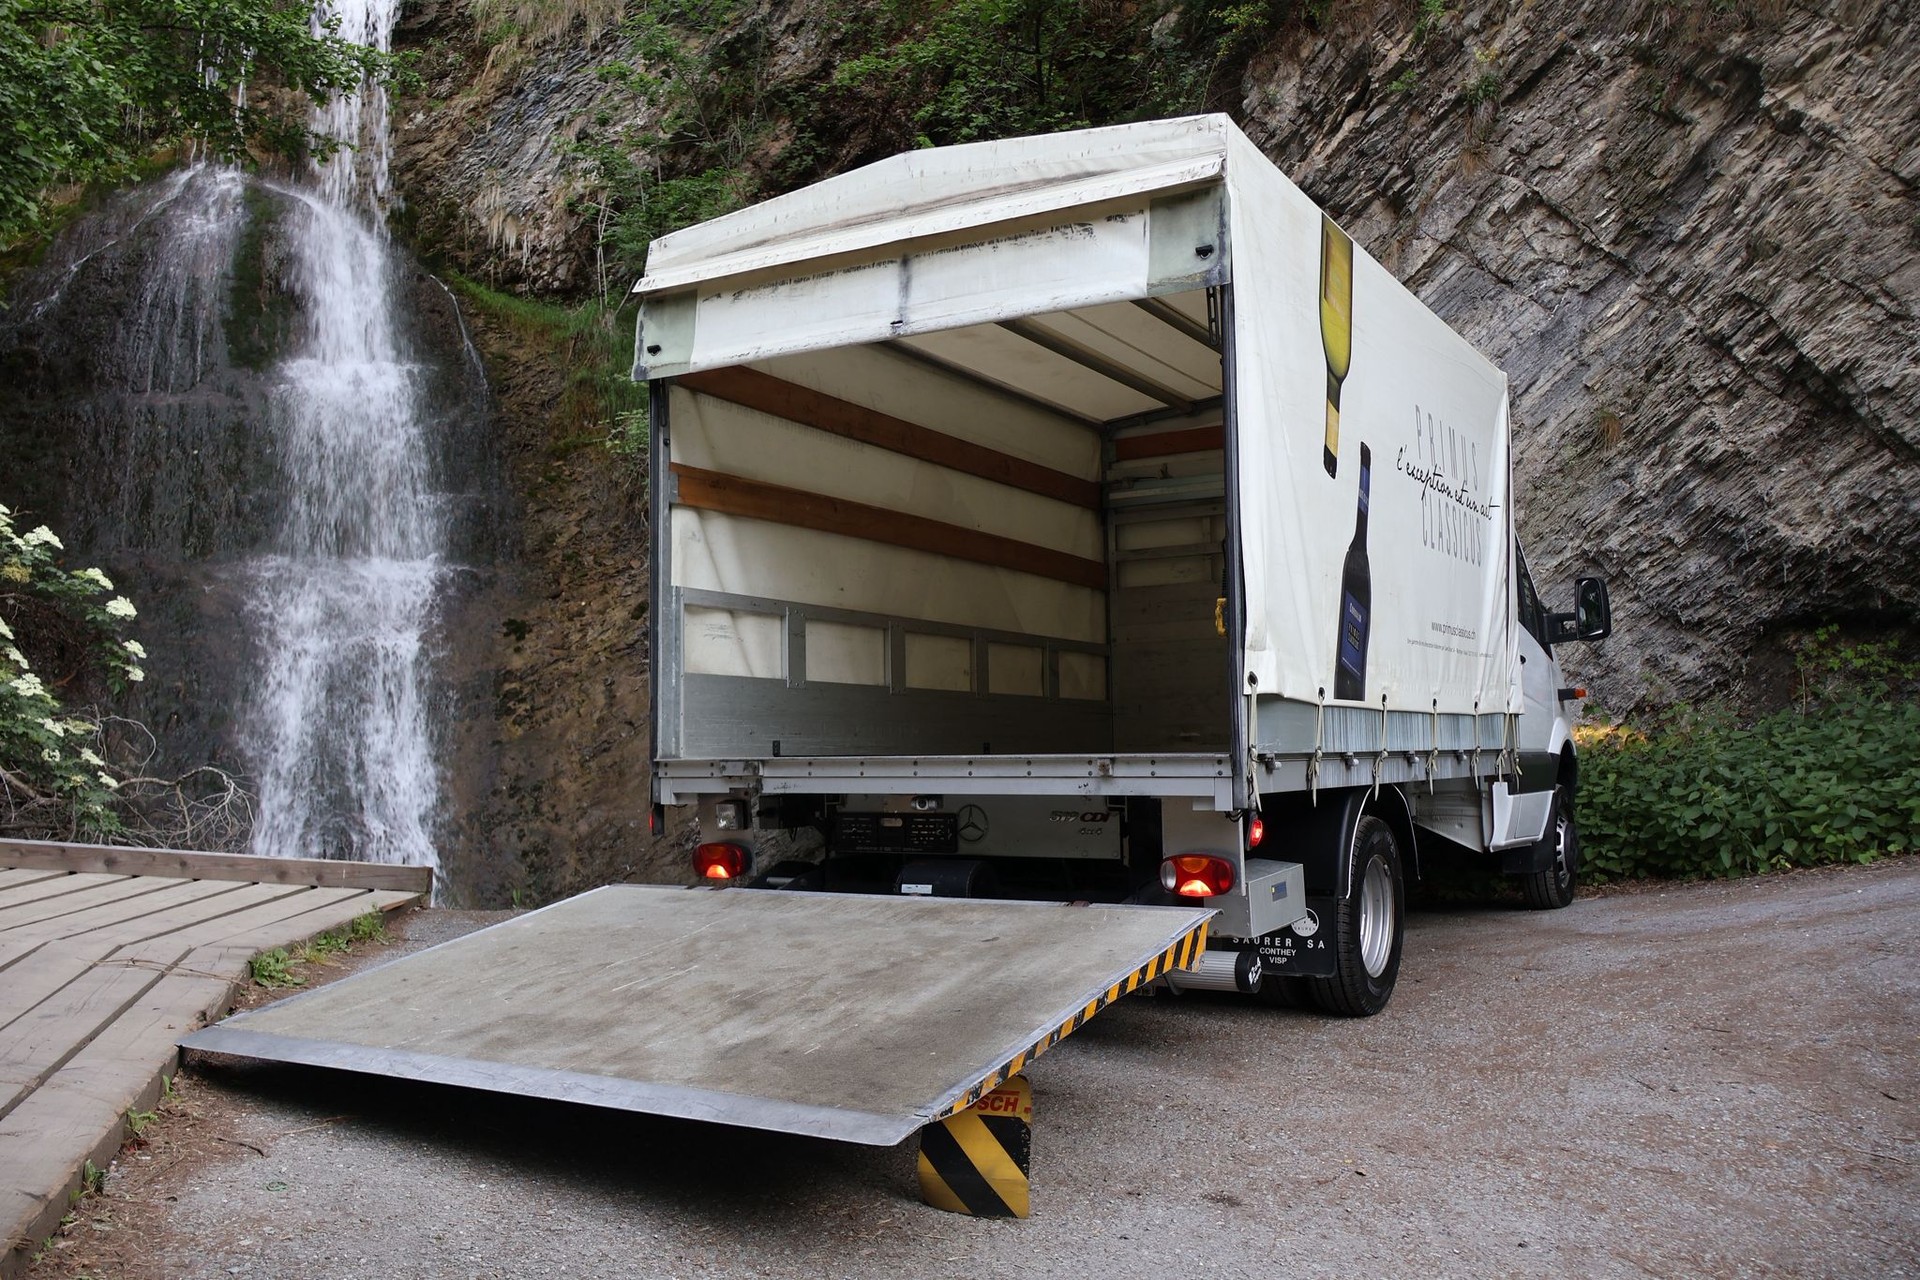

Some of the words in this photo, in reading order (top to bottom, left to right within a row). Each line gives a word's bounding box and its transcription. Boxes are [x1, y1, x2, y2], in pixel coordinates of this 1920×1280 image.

[1415, 404, 1478, 491] PRIMUS
[1479, 495, 1501, 521] art
[1422, 492, 1482, 568] CLASSICUS
[1232, 936, 1293, 948] SAURER
[1306, 939, 1326, 950] SA
[1259, 947, 1297, 957] CONTHEY
[1269, 956, 1288, 965] VISP
[966, 1095, 1019, 1113] SCH
